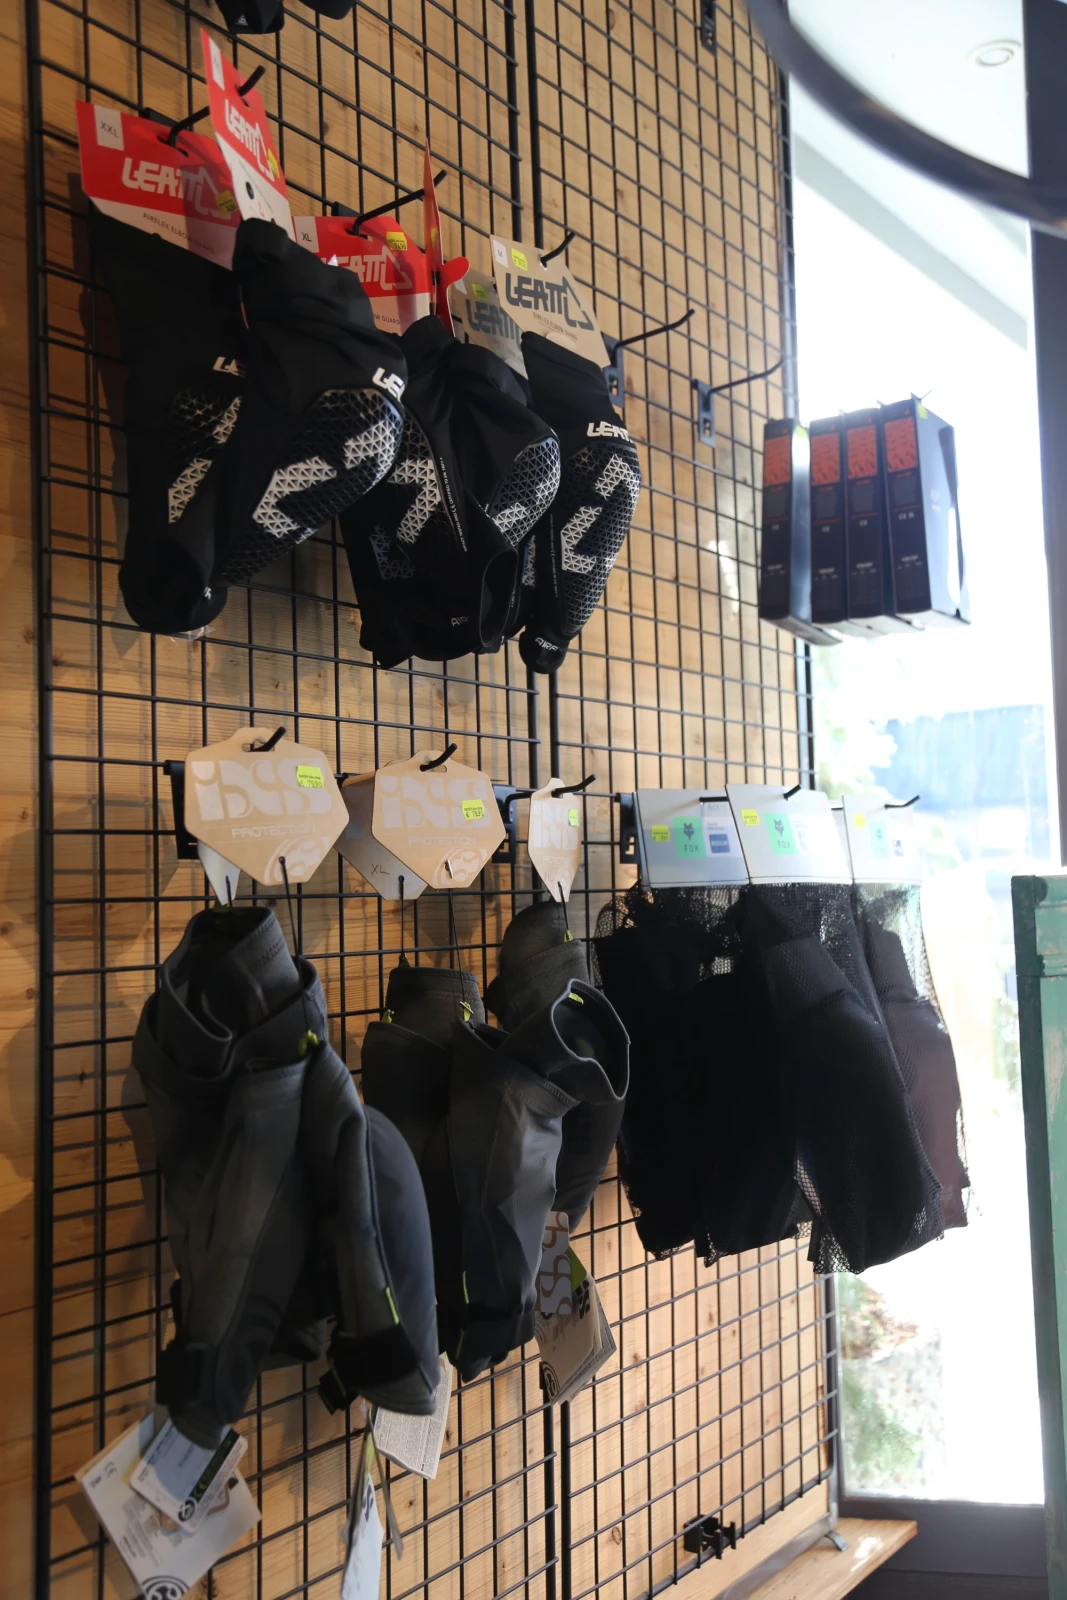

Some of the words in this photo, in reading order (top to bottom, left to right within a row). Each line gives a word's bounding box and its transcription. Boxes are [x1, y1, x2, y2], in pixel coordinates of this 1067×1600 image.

[100, 122, 120, 139] XXL
[142, 212, 170, 230] AIRFLEX
[301, 231, 312, 242] XL
[231, 824, 316, 840] PROTECTION
[408, 836, 476, 846] PROTECTION
[777, 840, 791, 849] FOX
[683, 844, 700, 853] FOX
[371, 863, 390, 876] XL
